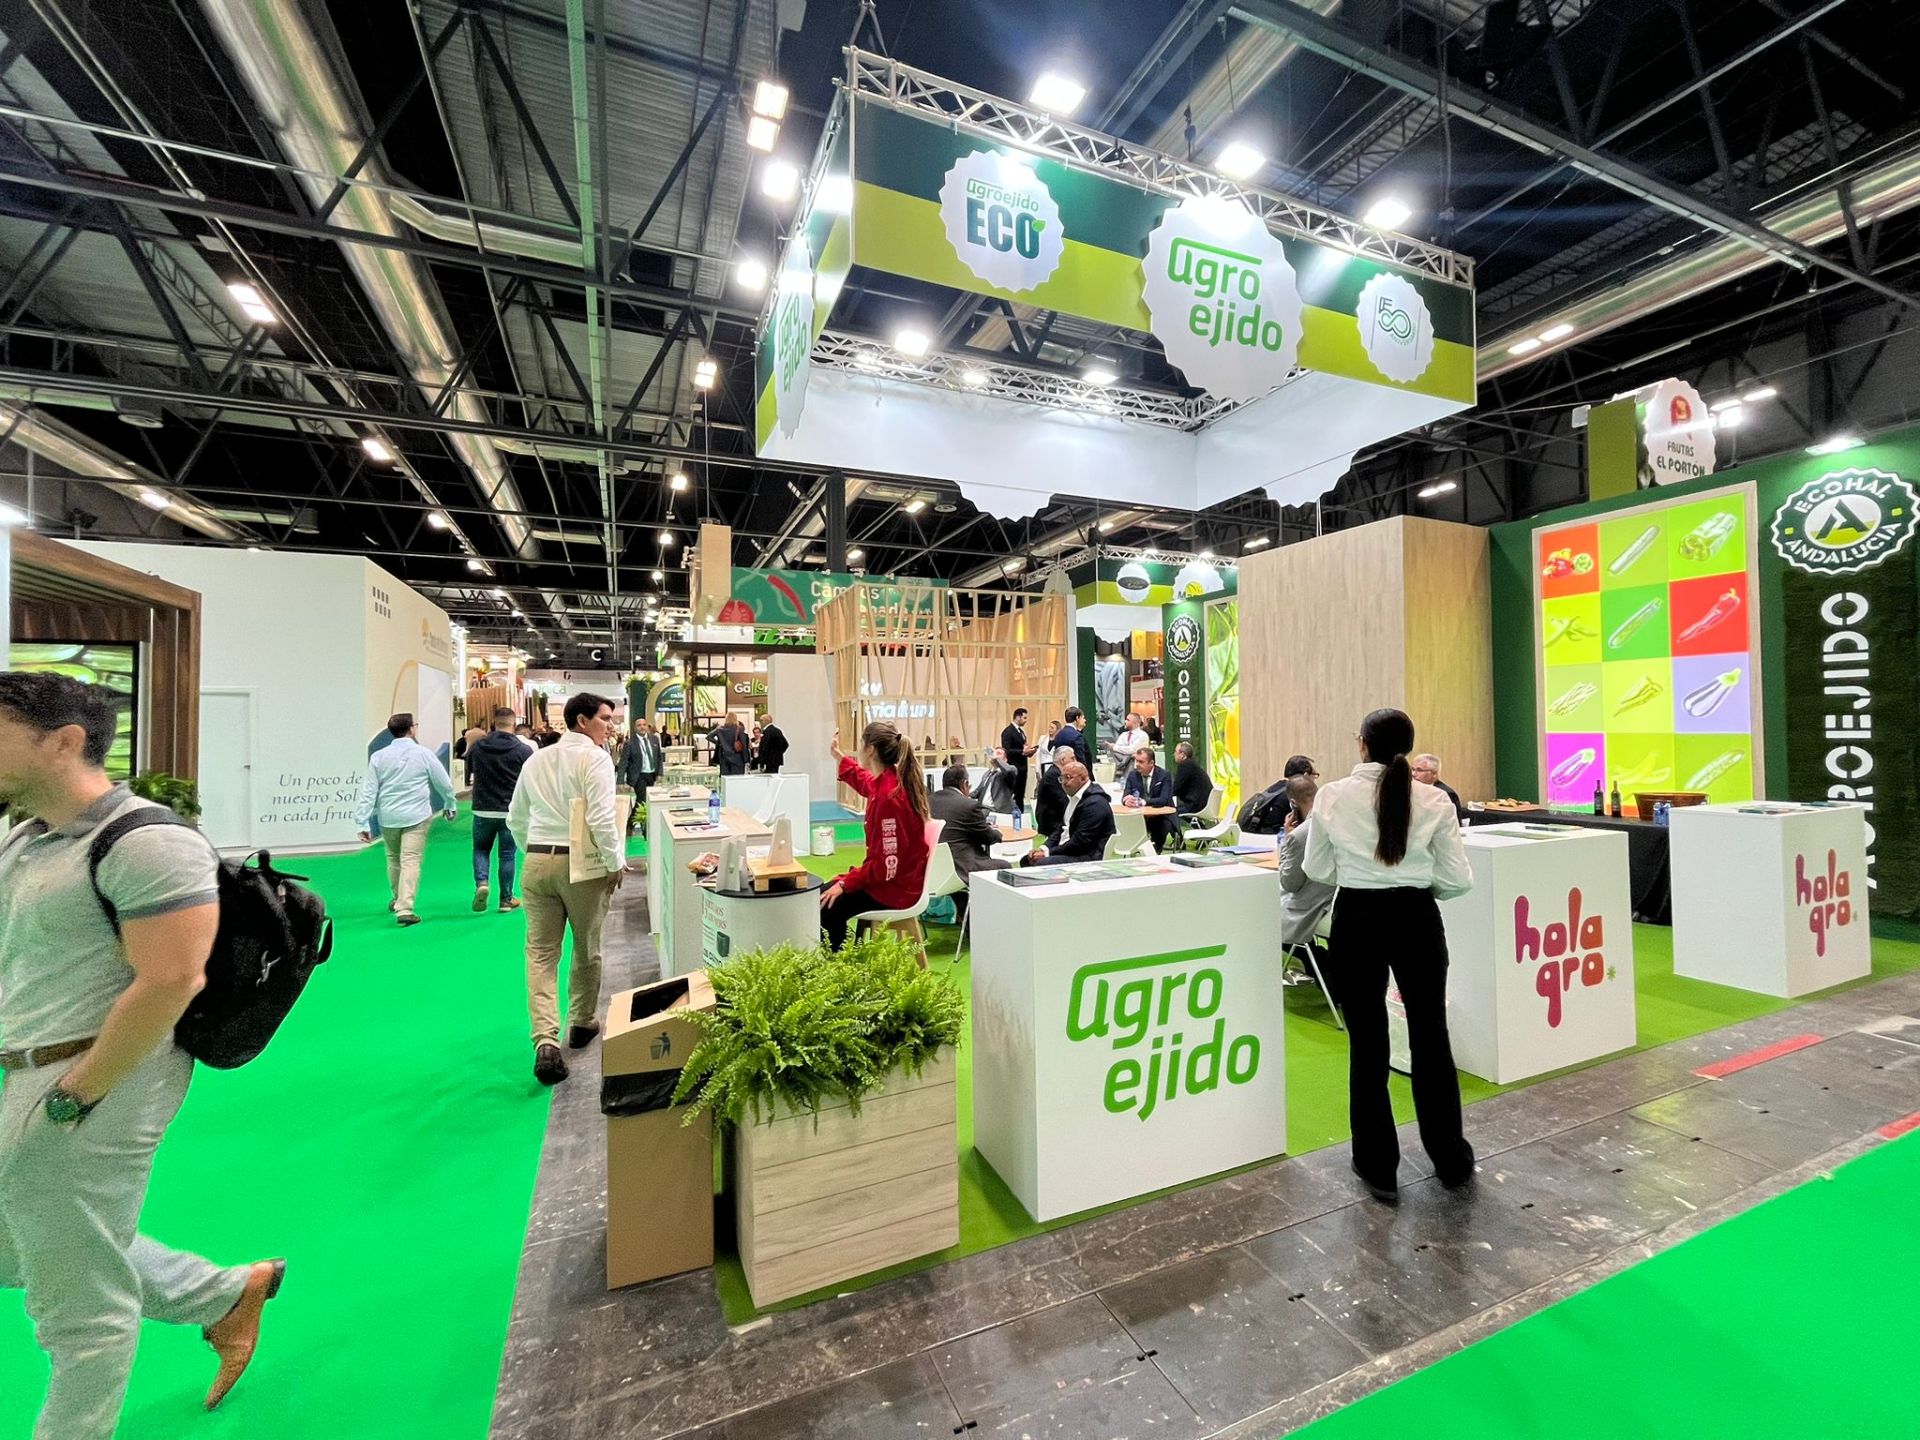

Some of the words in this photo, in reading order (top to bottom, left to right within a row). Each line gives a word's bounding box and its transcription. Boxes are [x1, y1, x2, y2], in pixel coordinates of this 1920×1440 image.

[966, 178, 1039, 212] agroejido
[966, 197, 1040, 260] ECO
[1167, 237, 1262, 300] agro
[1189, 299, 1283, 352] ejido
[784, 319, 807, 393] ejido
[1656, 455, 1667, 470] EL
[1667, 441, 1695, 457] FRUTAS
[1793, 477, 1892, 514] ECOHAL
[590, 649, 602, 662] C
[1820, 592, 1877, 889] ROEJIDO
[272, 793, 329, 805] nuestro
[334, 788, 358, 802] Sol
[279, 774, 301, 787] Un
[306, 776, 341, 790] poco
[345, 770, 363, 785] de
[260, 814, 277, 823] en
[283, 807, 319, 822] cada
[322, 806, 354, 824] frut
[1796, 848, 1850, 906] hola
[1514, 887, 1604, 964] hola
[1066, 944, 1227, 1050] agro
[1103, 1018, 1261, 1123] ejido
